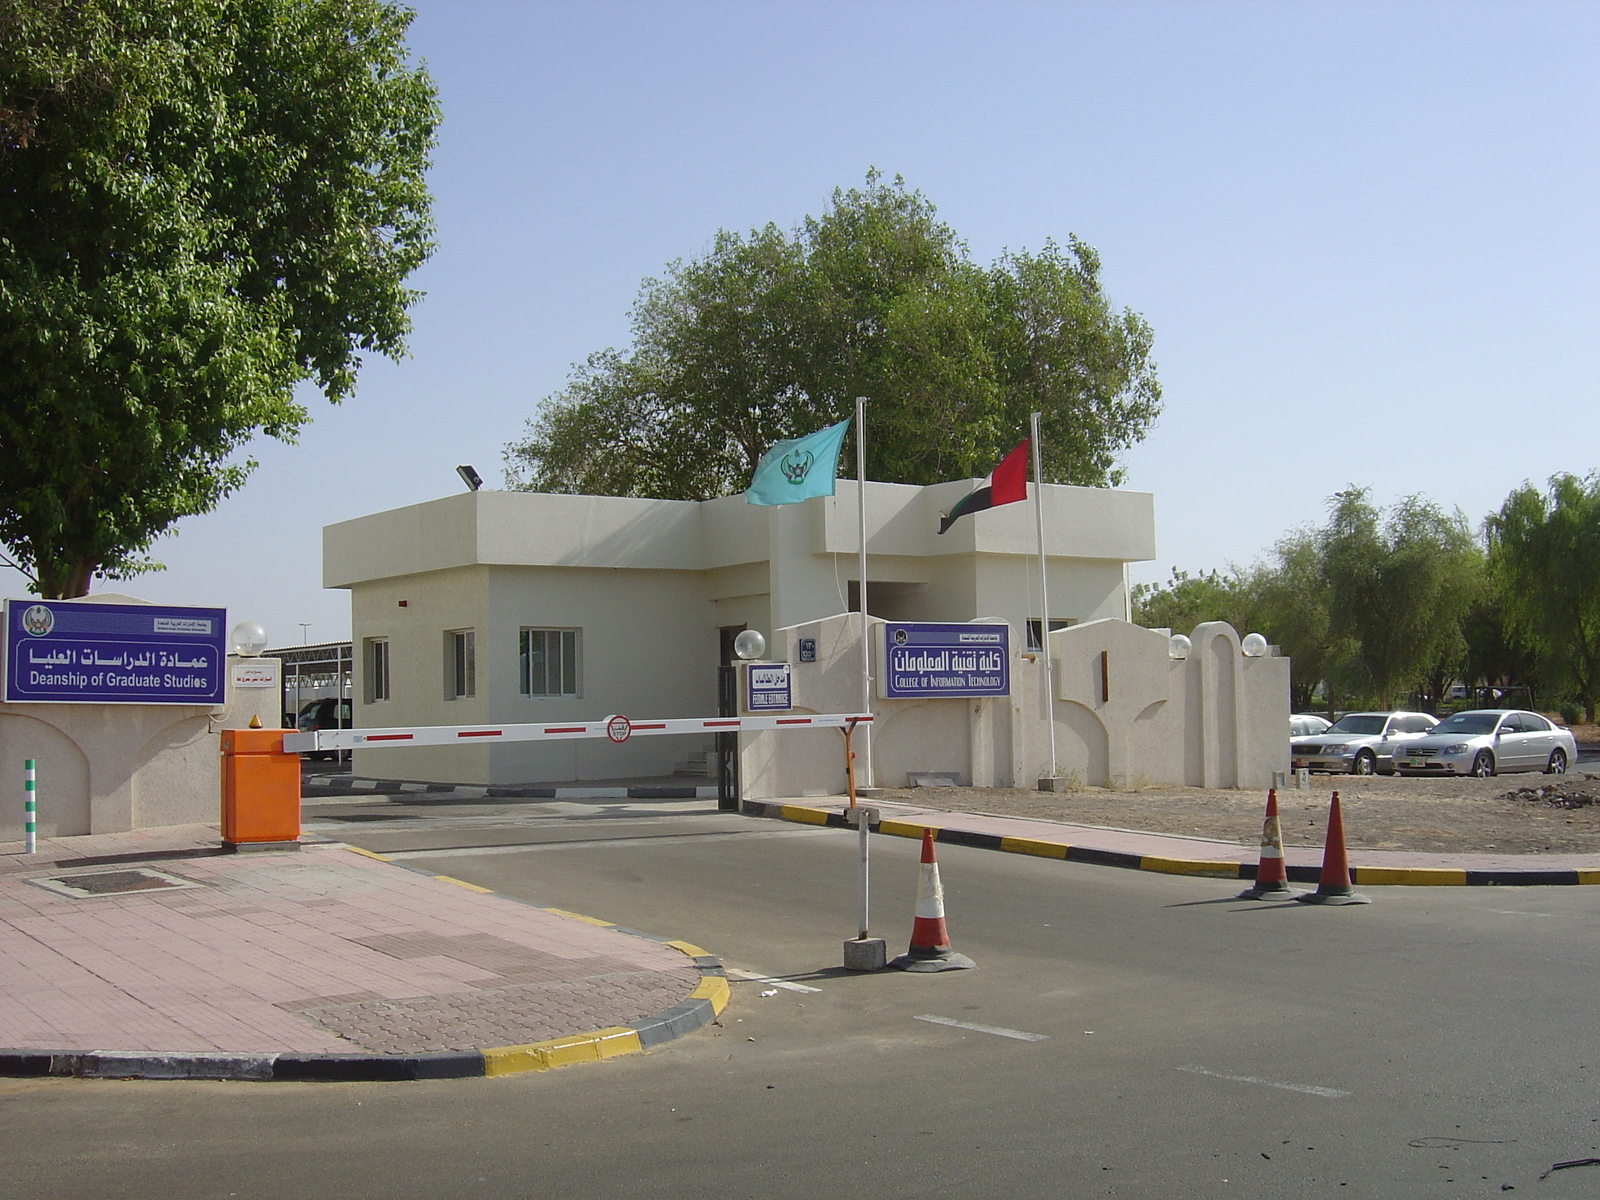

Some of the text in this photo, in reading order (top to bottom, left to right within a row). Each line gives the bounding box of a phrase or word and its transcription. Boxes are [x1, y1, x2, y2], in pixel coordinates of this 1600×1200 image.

[29, 647, 208, 670] عمادة الدراسات العليا
[894, 650, 1001, 675] كلية تقنية المعلومات
[30, 670, 88, 689] Deanship
[91, 672, 104, 687] of
[106, 673, 161, 688] Graduate
[895, 673, 1001, 688] COLLEGE OF INFORMATION TECHNOLOGY
